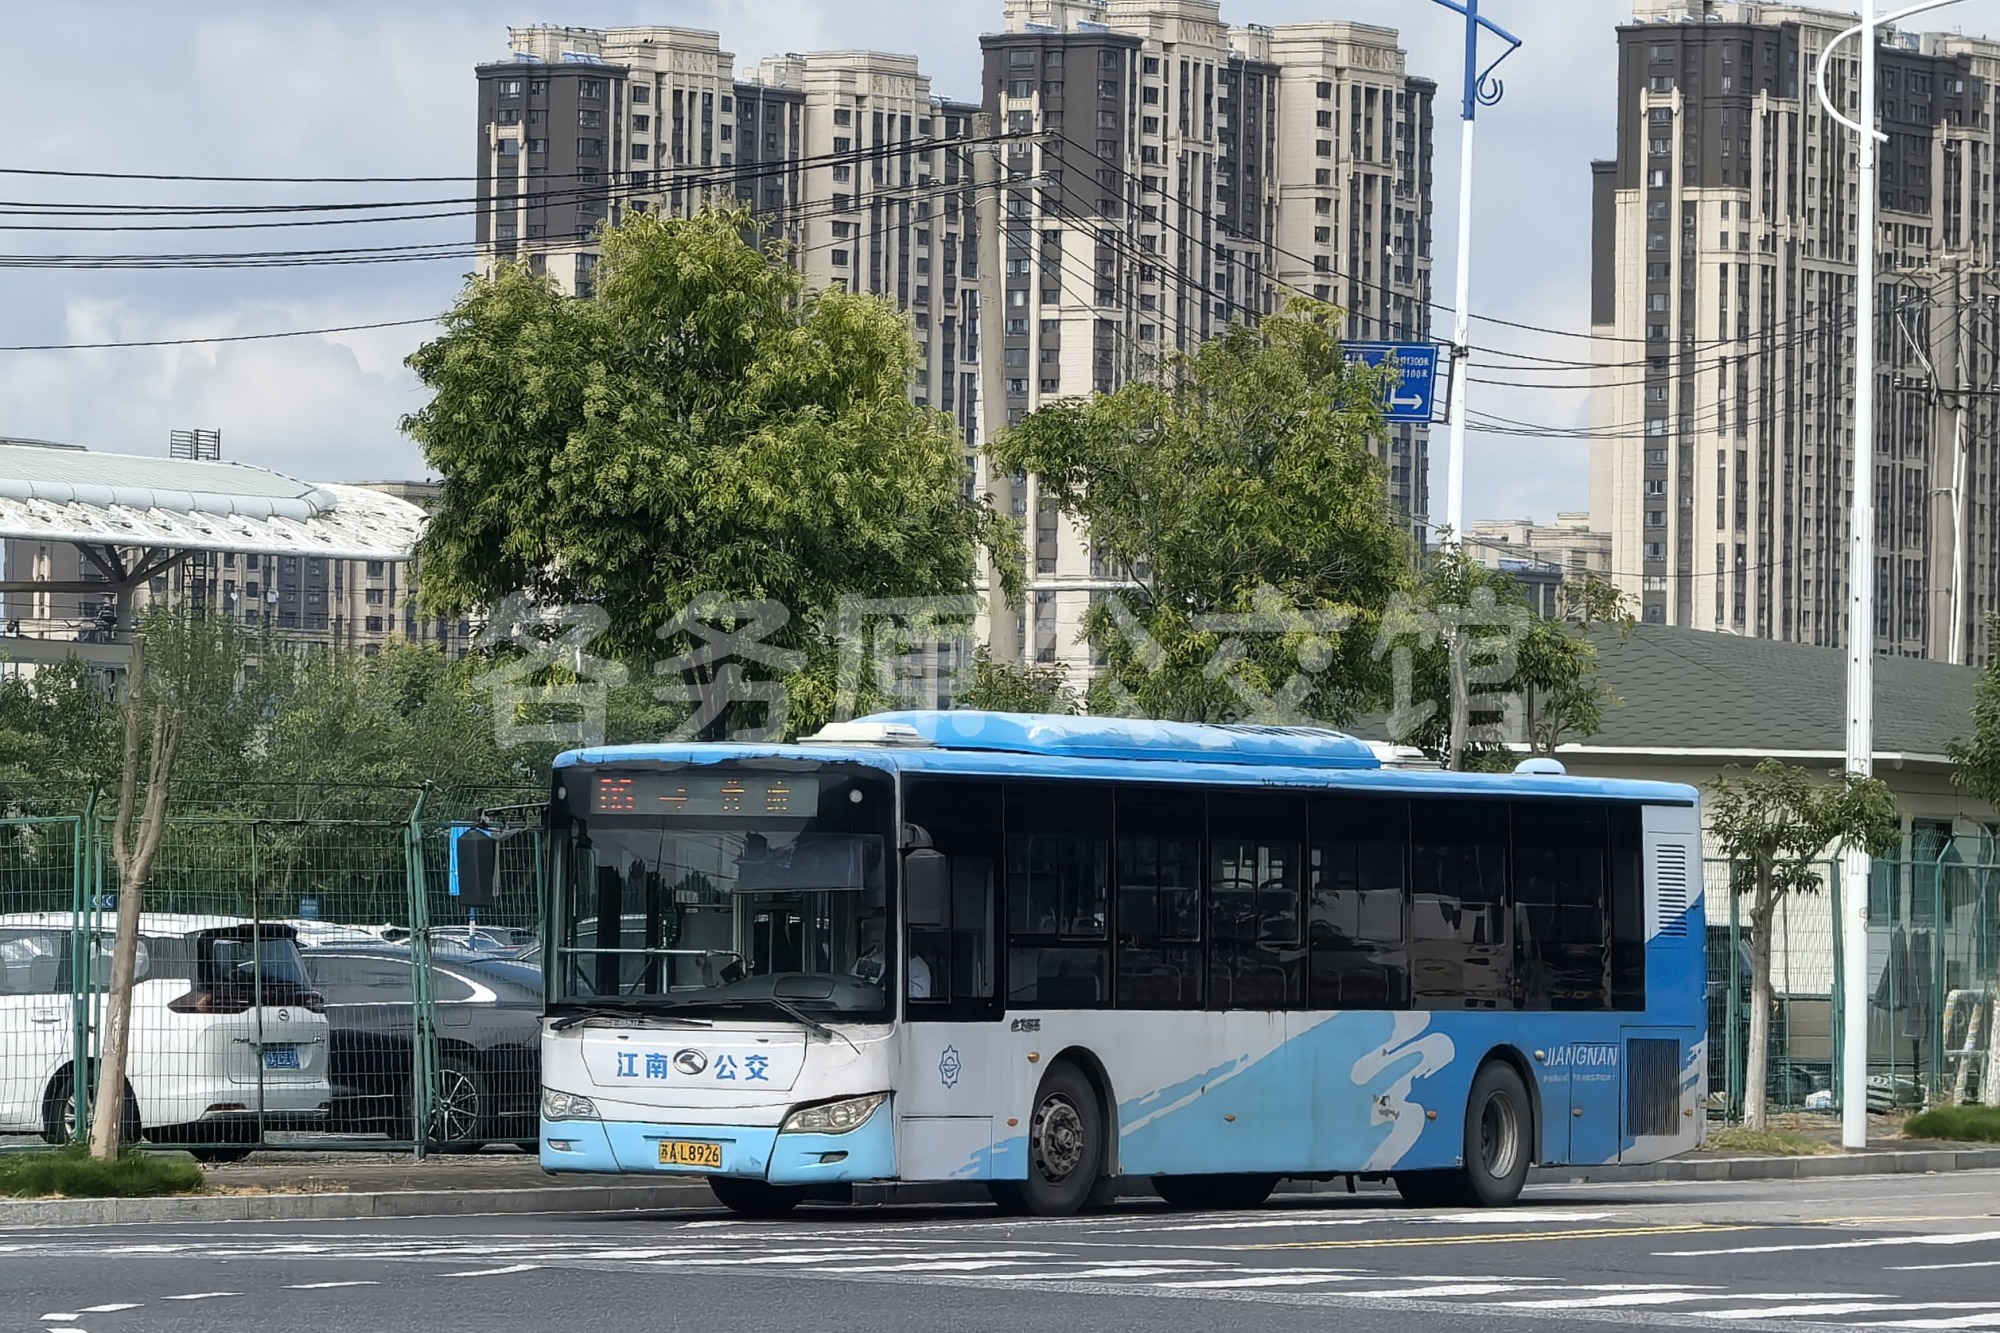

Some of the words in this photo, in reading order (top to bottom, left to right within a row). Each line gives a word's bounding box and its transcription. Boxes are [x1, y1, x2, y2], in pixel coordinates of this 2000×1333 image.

[616, 1051, 668, 1079] 江南
[713, 1054, 769, 1081] 公交
[1544, 1045, 1618, 1066] JIANGNAN
[660, 1142, 719, 1163] 苏AL8926
